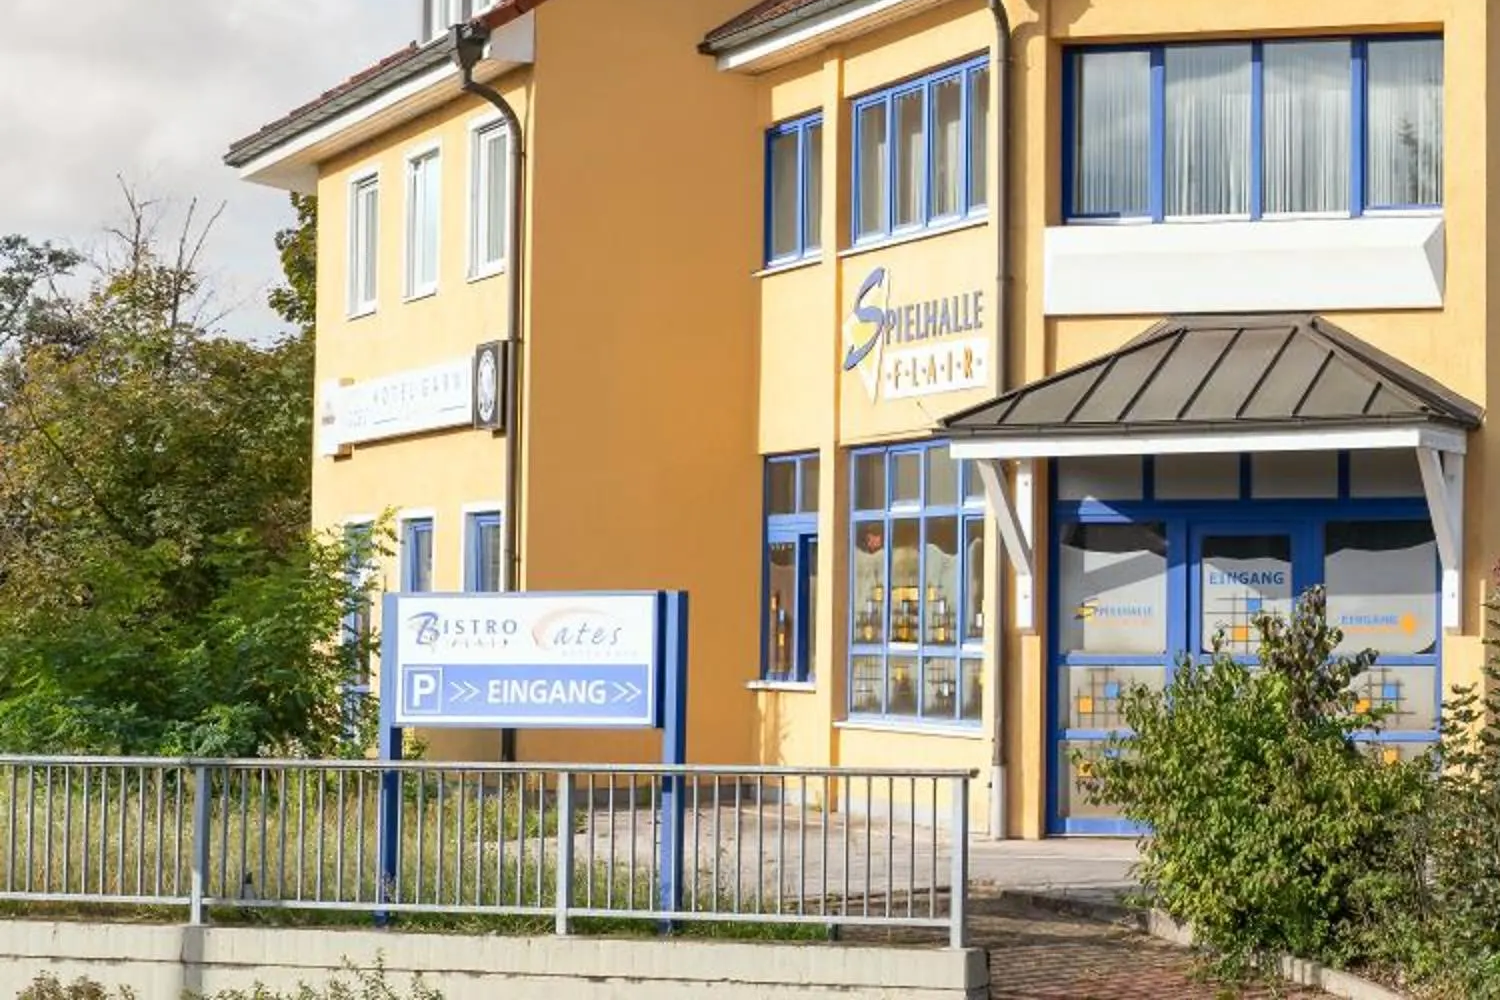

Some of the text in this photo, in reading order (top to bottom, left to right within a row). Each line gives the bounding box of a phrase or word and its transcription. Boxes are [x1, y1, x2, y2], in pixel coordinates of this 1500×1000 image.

[843, 267, 984, 371] SPIELHALLE
[1209, 571, 1285, 585] EINGANG
[407, 611, 518, 646] BISTRO
[411, 673, 607, 707] P EINGANG
